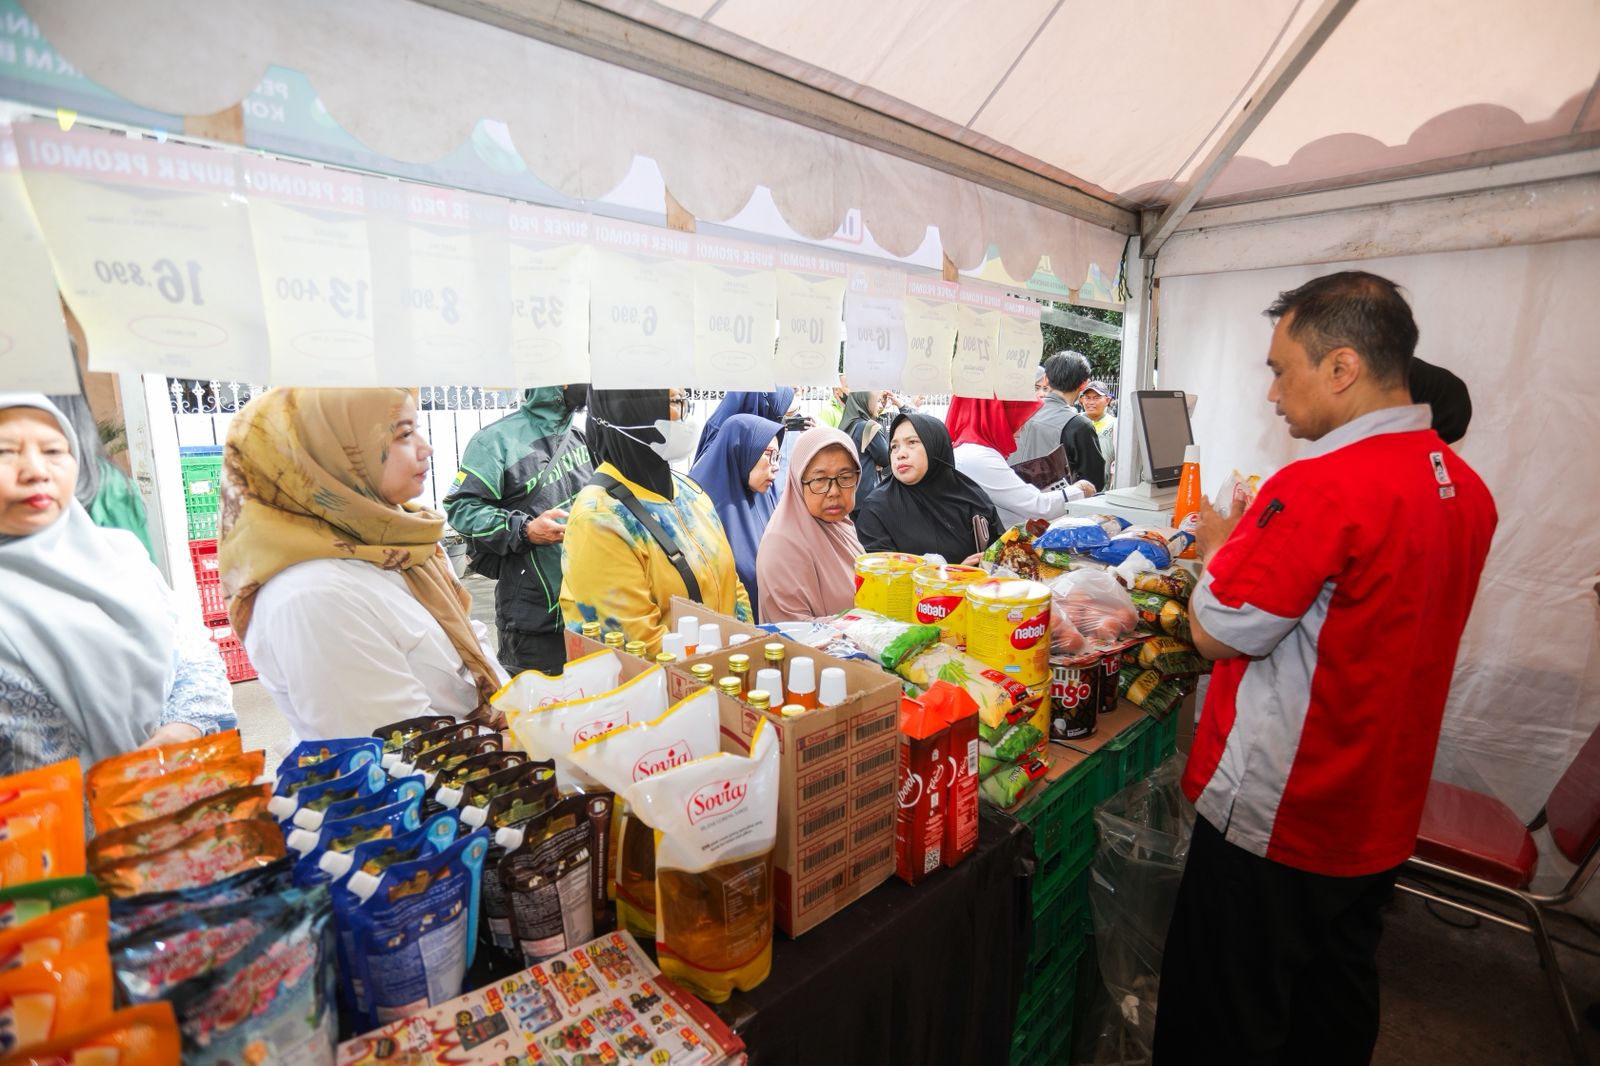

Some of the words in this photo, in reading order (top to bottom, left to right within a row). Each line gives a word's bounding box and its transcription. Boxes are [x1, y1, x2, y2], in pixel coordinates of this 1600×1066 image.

[917, 602, 946, 618] nabati
[1014, 624, 1046, 640] nabati
[1050, 682, 1091, 708] ngo
[637, 749, 688, 779] Sovia
[693, 781, 743, 816] Sovia
